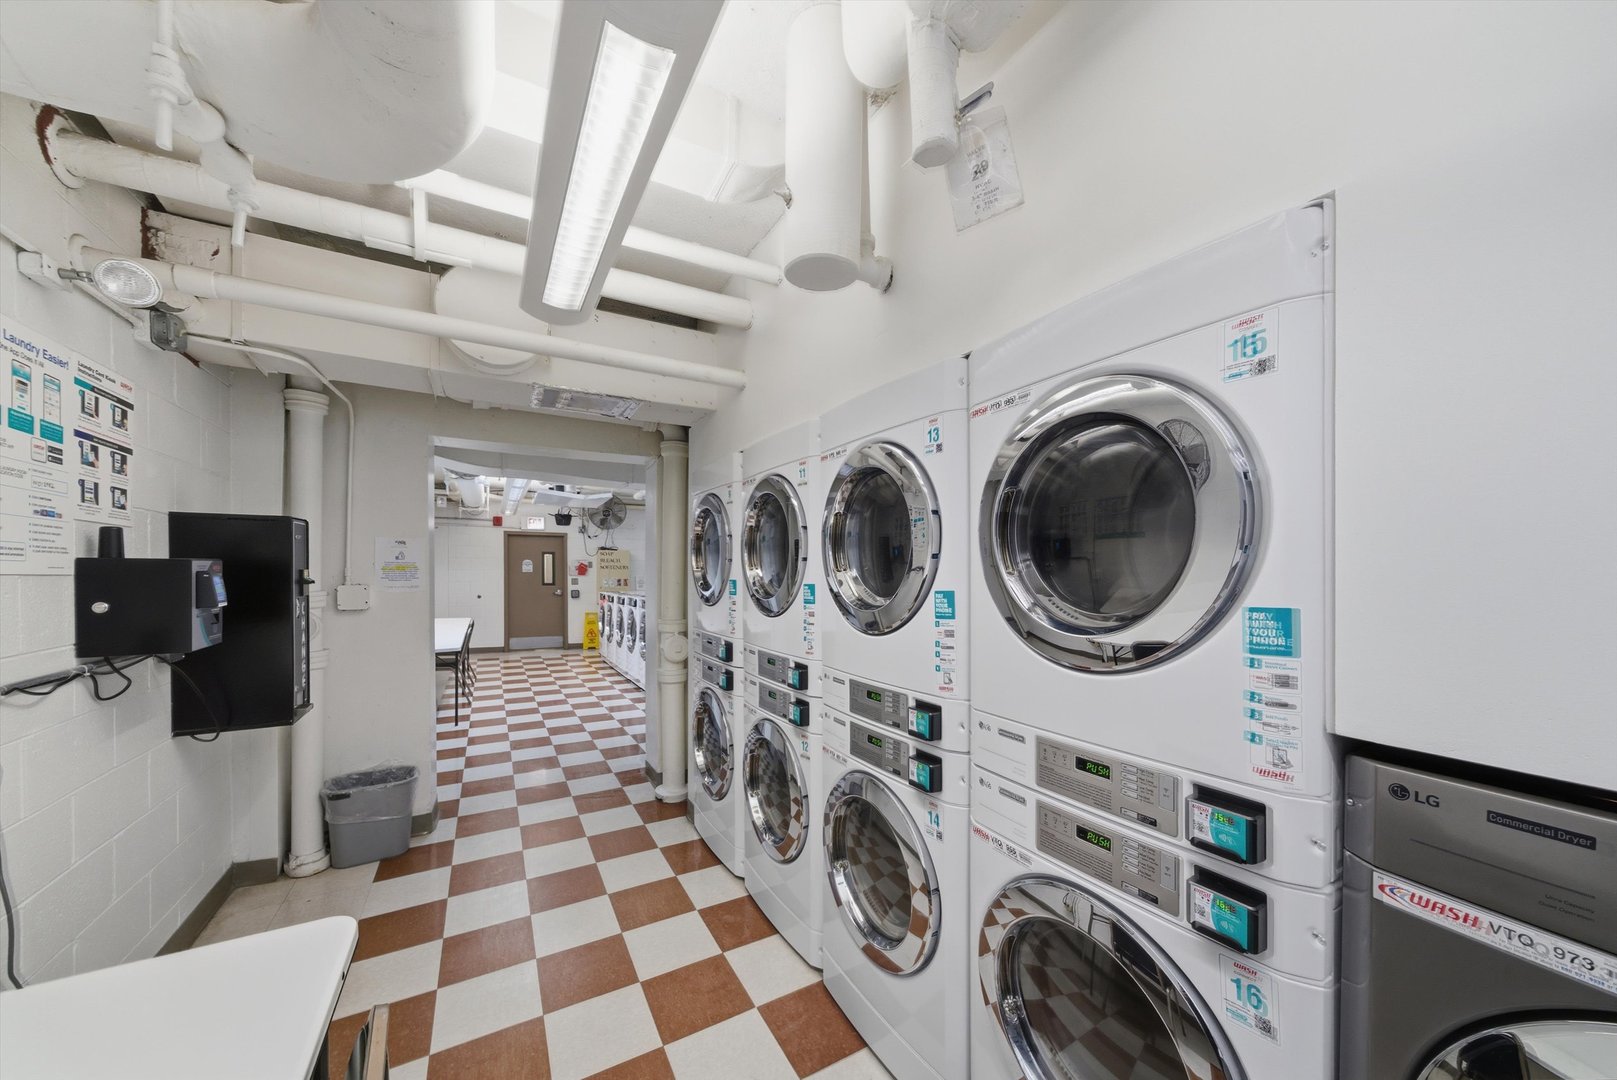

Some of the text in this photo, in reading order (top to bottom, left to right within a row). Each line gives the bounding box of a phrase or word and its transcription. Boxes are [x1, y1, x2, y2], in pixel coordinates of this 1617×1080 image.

[2, 327, 69, 370] Laundry Easier!
[927, 426, 940, 443] 13
[1086, 762, 1109, 776] PUSH
[1414, 790, 1440, 808] LG
[927, 810, 940, 828] 14
[1489, 813, 1592, 848] Commercial Dryer
[1086, 832, 1110, 848] PUSH
[1409, 892, 1480, 929] WASH
[1489, 920, 1534, 949] VTQ
[1553, 946, 1595, 972] 973
[1230, 977, 1263, 1011] 16
